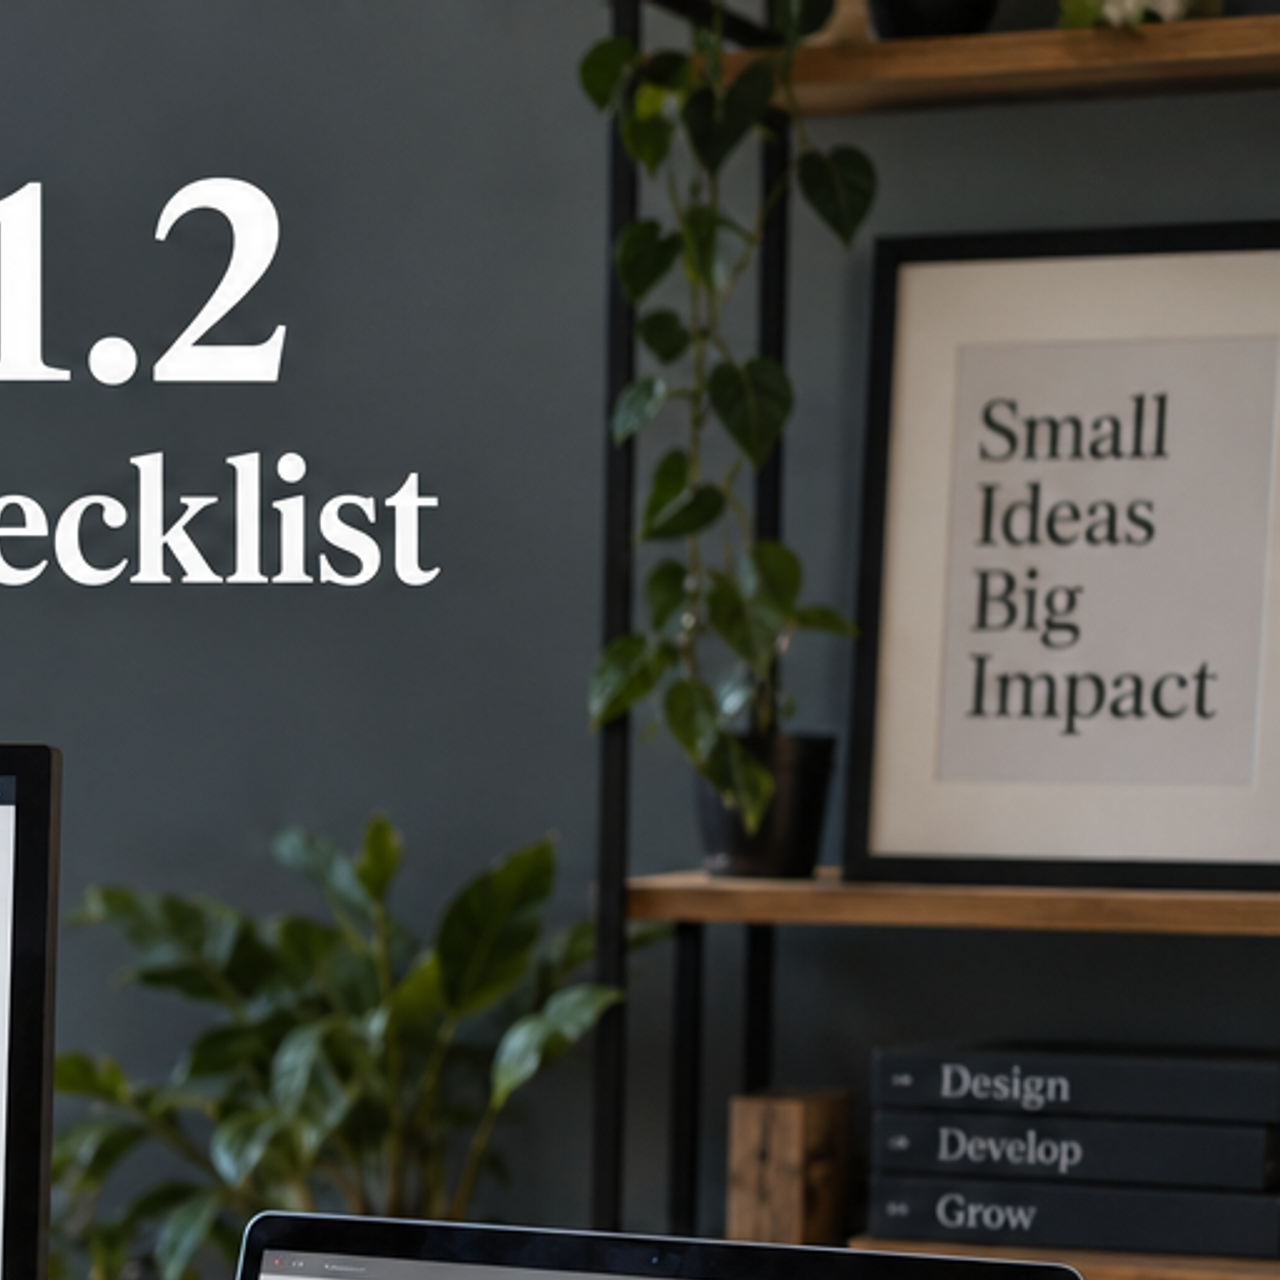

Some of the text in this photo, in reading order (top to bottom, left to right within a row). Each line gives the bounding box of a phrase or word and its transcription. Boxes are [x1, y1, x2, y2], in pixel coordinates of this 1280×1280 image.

[979, 393, 1167, 460] Small
[980, 481, 1155, 547] Ideas
[971, 567, 1084, 650] Big
[965, 651, 1218, 736] Impact
[940, 1063, 1070, 1110] Design
[938, 1127, 1083, 1174] Develop
[935, 1194, 1036, 1230] Grow
